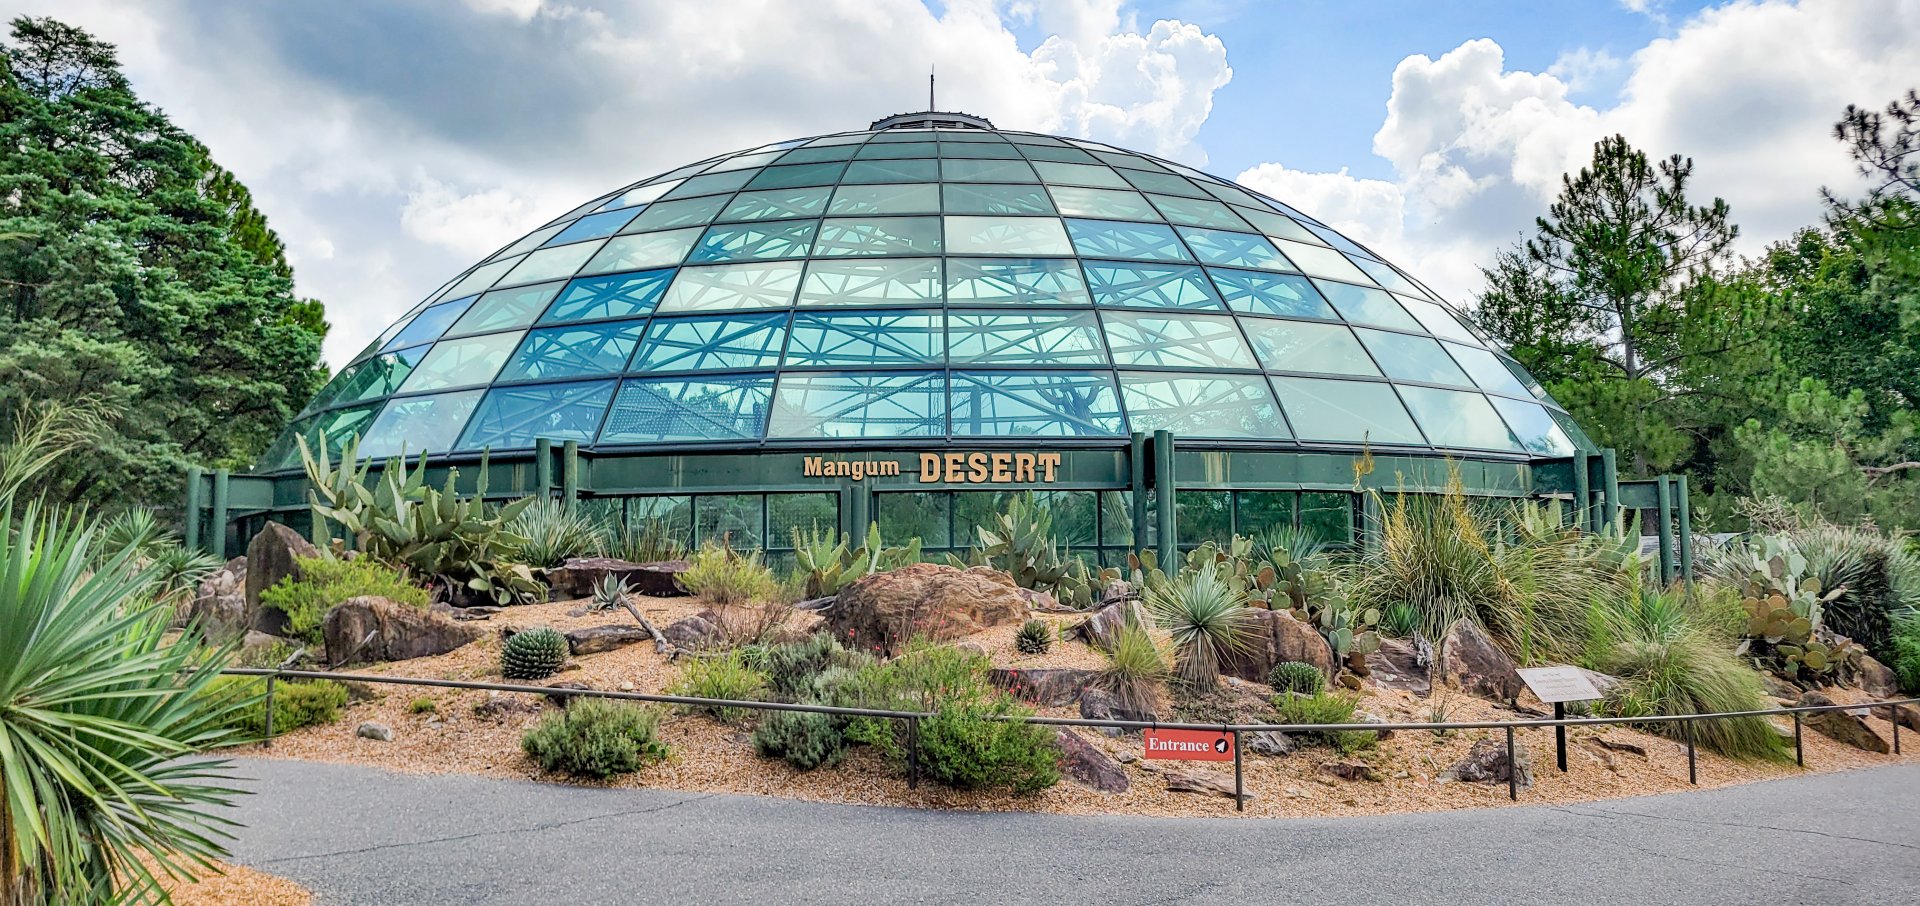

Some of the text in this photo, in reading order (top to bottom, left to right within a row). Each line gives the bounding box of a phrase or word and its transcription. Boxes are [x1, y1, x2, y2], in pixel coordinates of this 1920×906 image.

[803, 453, 1061, 483] Mangum DESERT
[1149, 737, 1210, 752] Entrance
